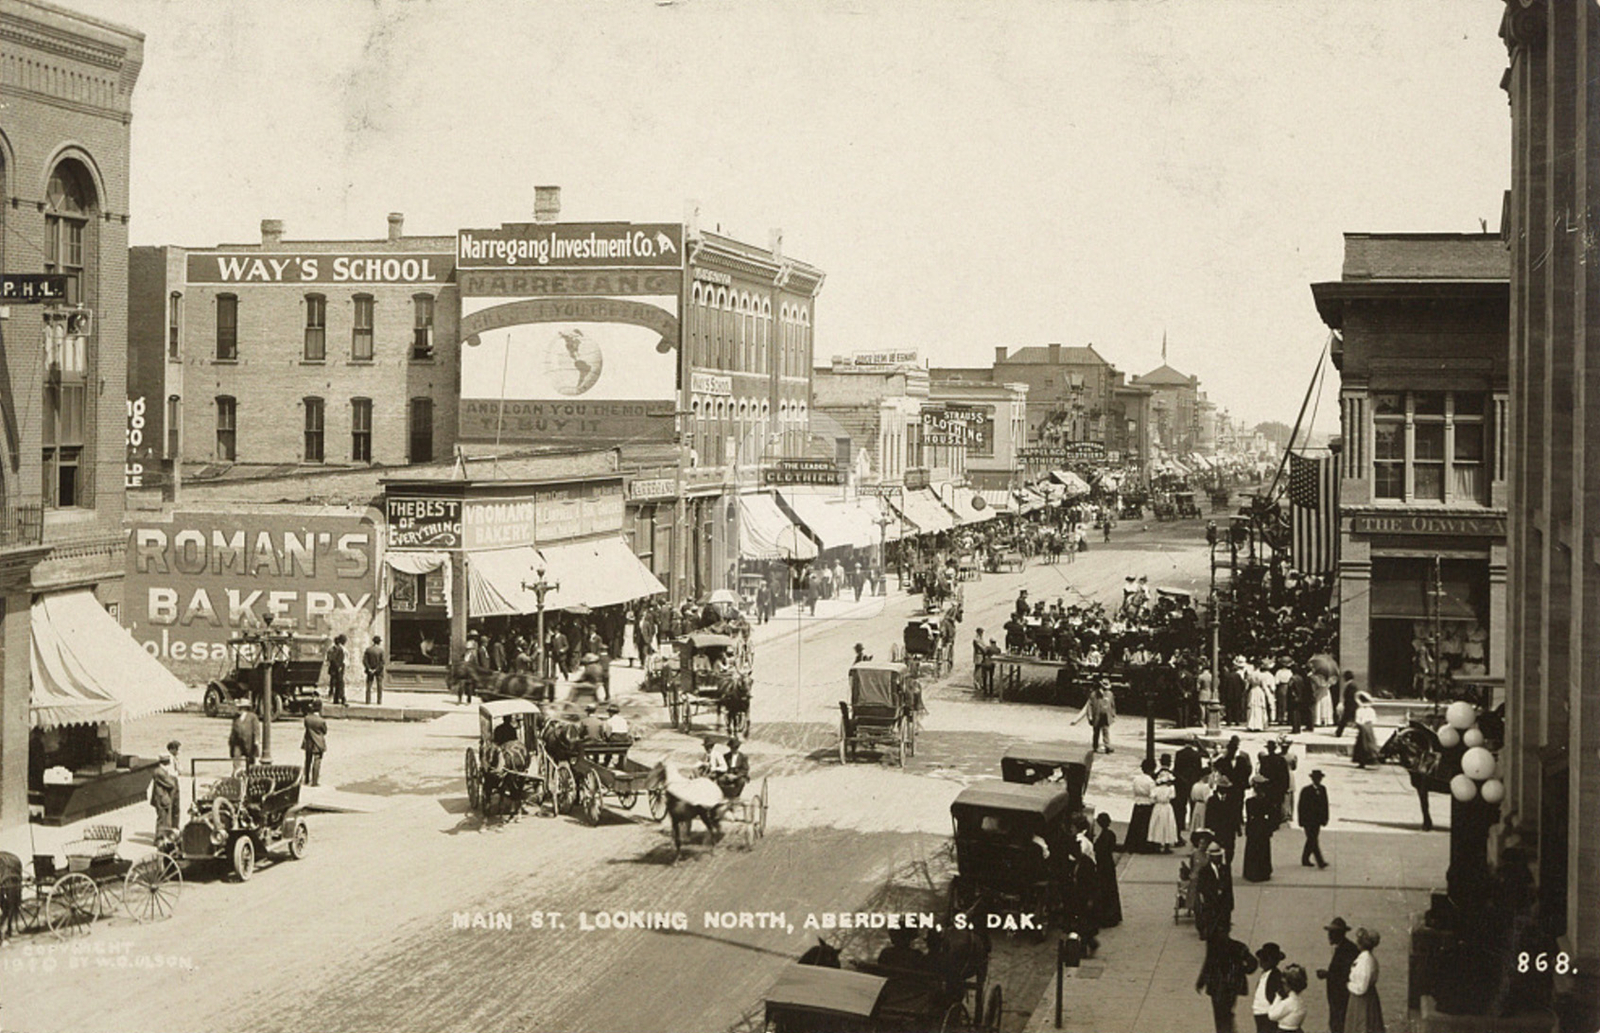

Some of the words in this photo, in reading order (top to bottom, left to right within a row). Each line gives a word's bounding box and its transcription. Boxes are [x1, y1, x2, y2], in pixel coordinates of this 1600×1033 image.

[461, 233, 549, 265] Narregang
[551, 231, 632, 258] Investment
[633, 231, 656, 258] Co.
[217, 257, 318, 281] WAY'S
[332, 257, 436, 281] SCHOOL
[550, 404, 586, 414] YOU
[784, 462, 799, 470] THE
[766, 471, 846, 483] CLOTHIERS
[390, 502, 415, 517] THE
[416, 500, 459, 518] BEST
[399, 517, 416, 529] OF
[1361, 518, 1401, 531] THE
[389, 521, 462, 546] EVERYTHING
[148, 587, 372, 629] BAKERY
